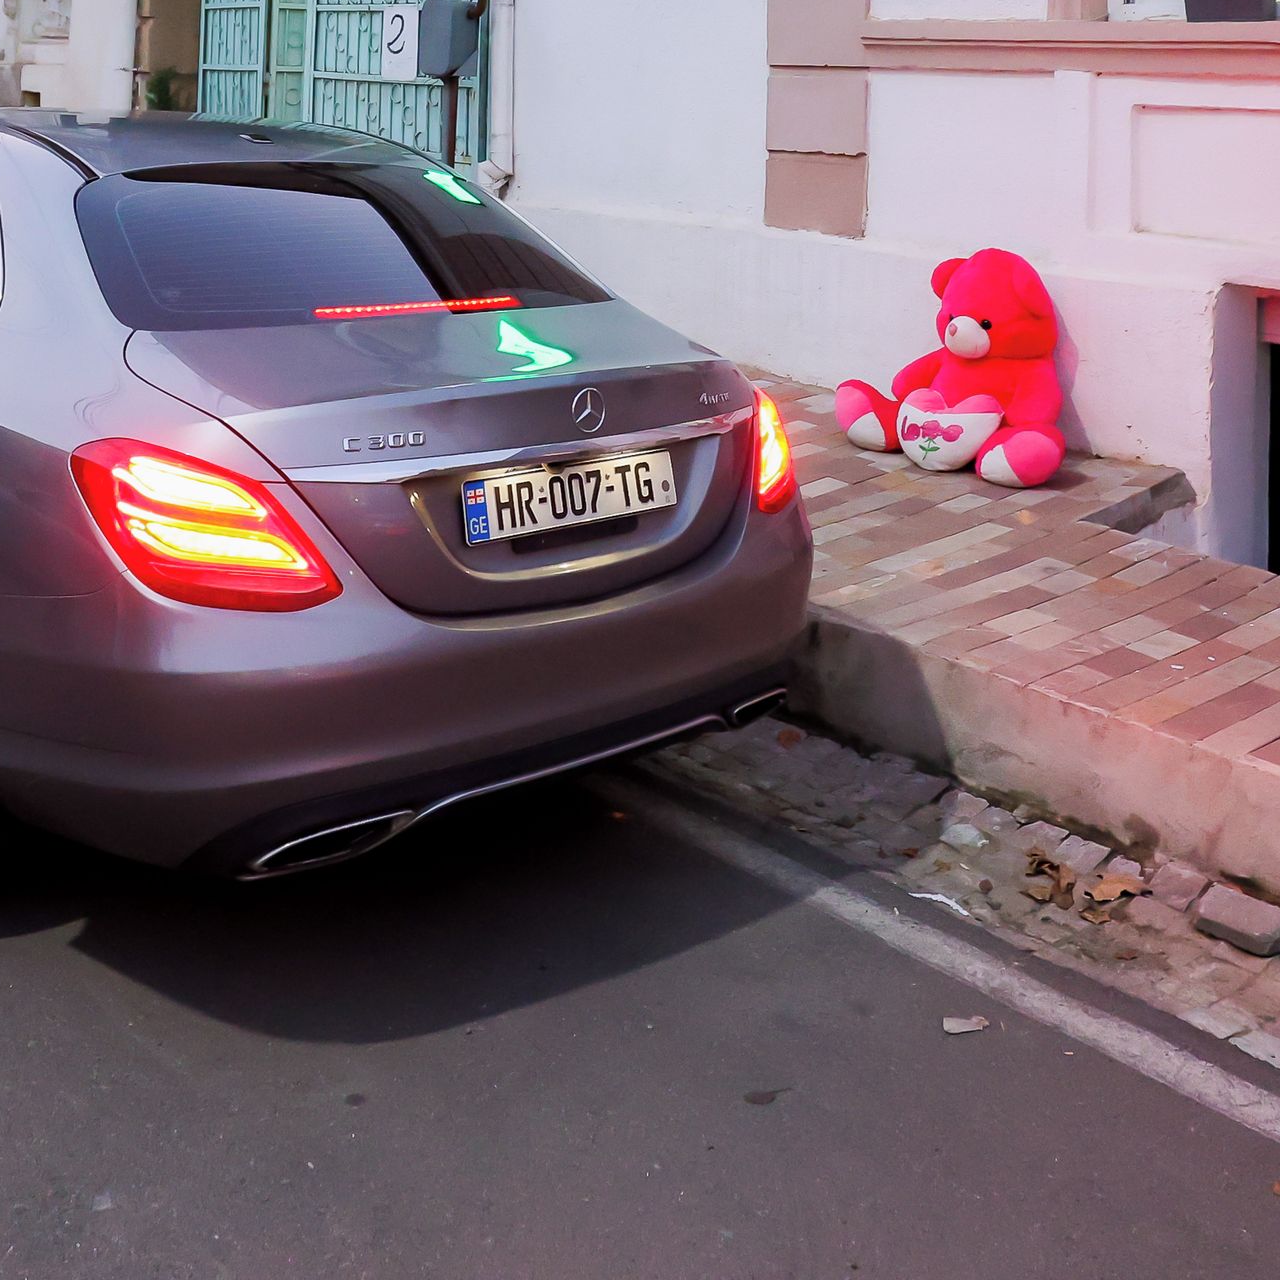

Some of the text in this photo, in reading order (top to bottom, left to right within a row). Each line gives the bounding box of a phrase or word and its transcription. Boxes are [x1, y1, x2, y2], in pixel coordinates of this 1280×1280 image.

[386, 13, 406, 55] 2
[342, 430, 427, 452] C 300
[469, 461, 656, 535] GE HR-007-TG
